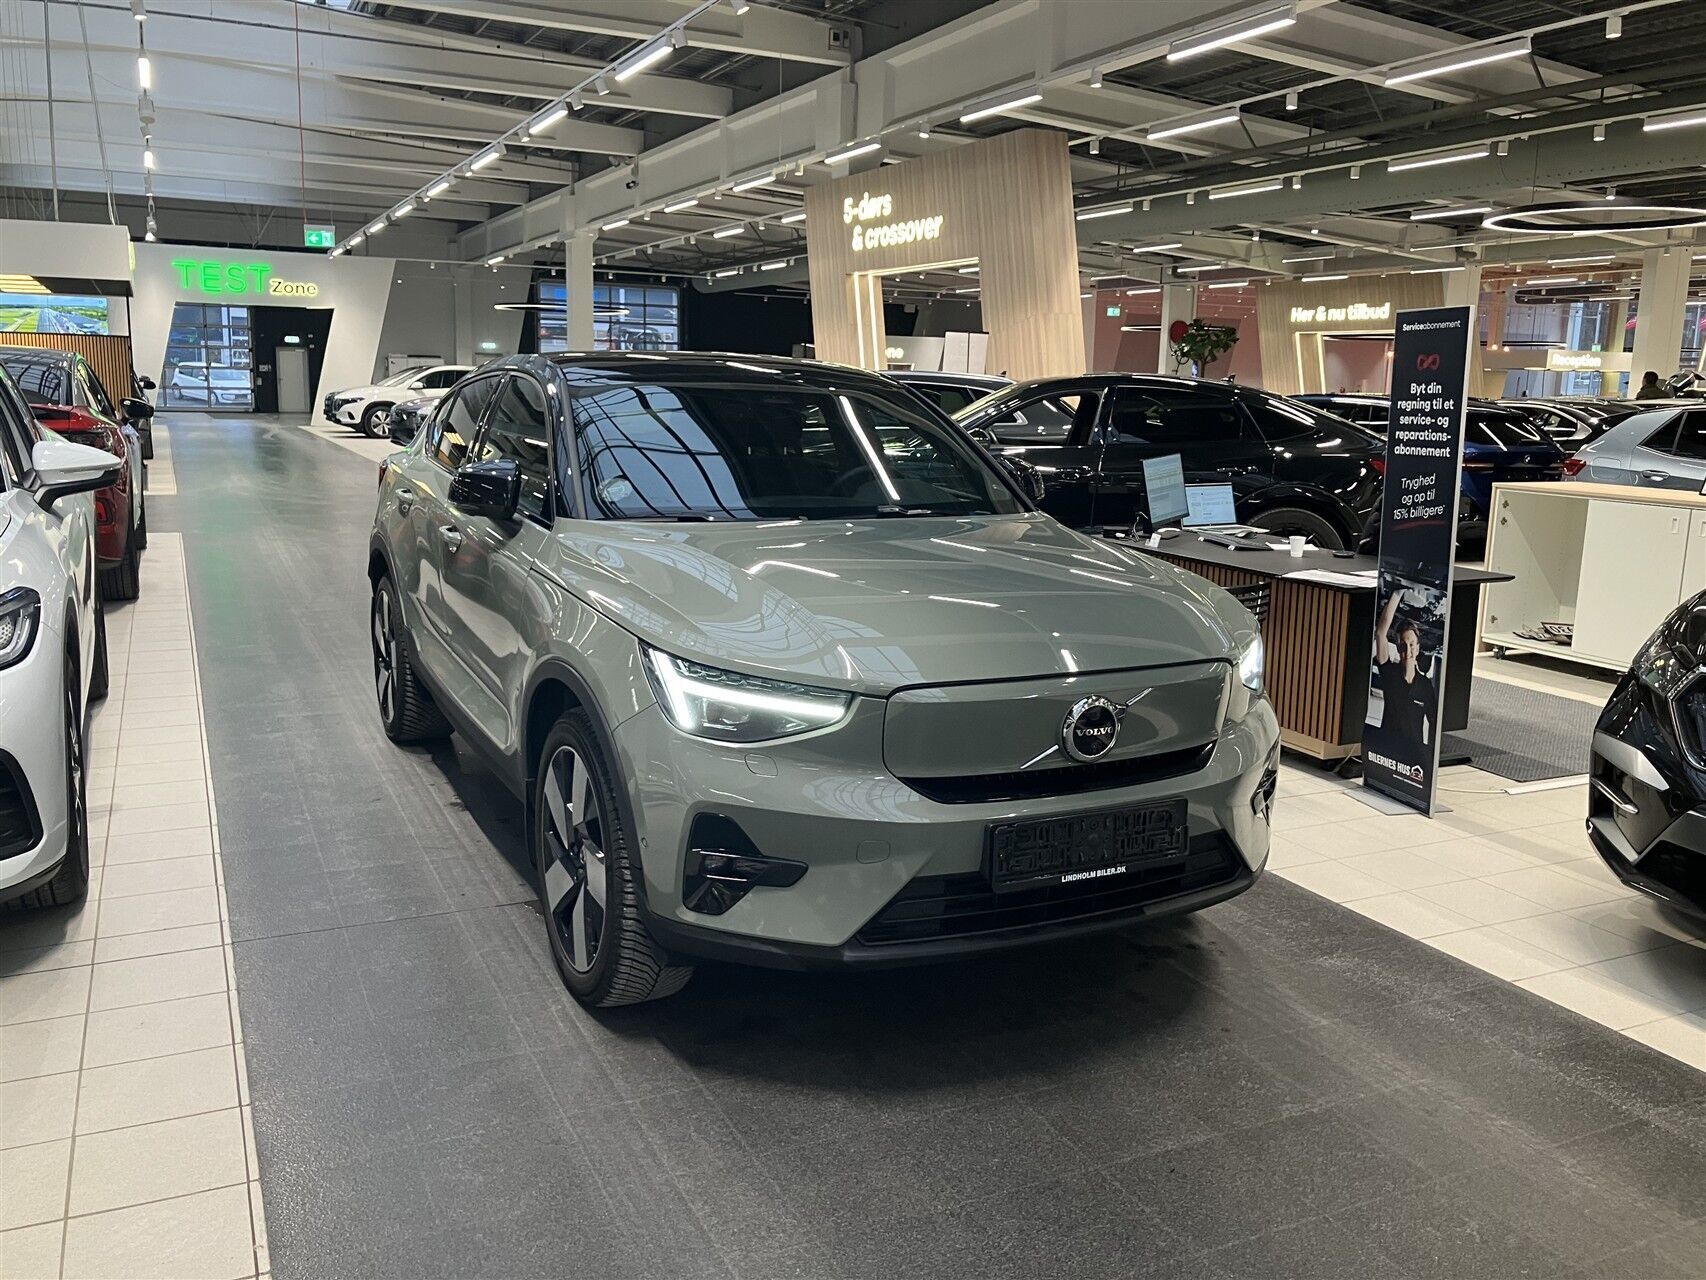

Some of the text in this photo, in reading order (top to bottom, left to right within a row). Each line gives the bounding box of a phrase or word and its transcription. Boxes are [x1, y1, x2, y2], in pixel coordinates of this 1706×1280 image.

[852, 215, 944, 252] & crossover
[172, 259, 318, 297] TEST Zone
[1315, 305, 1327, 322] &
[1327, 308, 1346, 321] nu
[1346, 302, 1391, 321] tilbud
[1402, 320, 1461, 331] Serviceabonnement
[1551, 353, 1602, 369] Reception
[1410, 382, 1442, 395] Byt din
[1397, 398, 1455, 412] regning til et
[1399, 413, 1449, 428] service- og
[1395, 429, 1452, 442] reparations-
[1394, 444, 1451, 458] abonnement
[1401, 472, 1436, 491] Tryghed
[1401, 489, 1436, 506] og op til
[1393, 507, 1409, 521] 15%
[1075, 726, 1113, 737] VOLVO
[1368, 751, 1411, 775] BILERNES HUS
[1061, 865, 1127, 883] LINDHOLM BILER.DK
